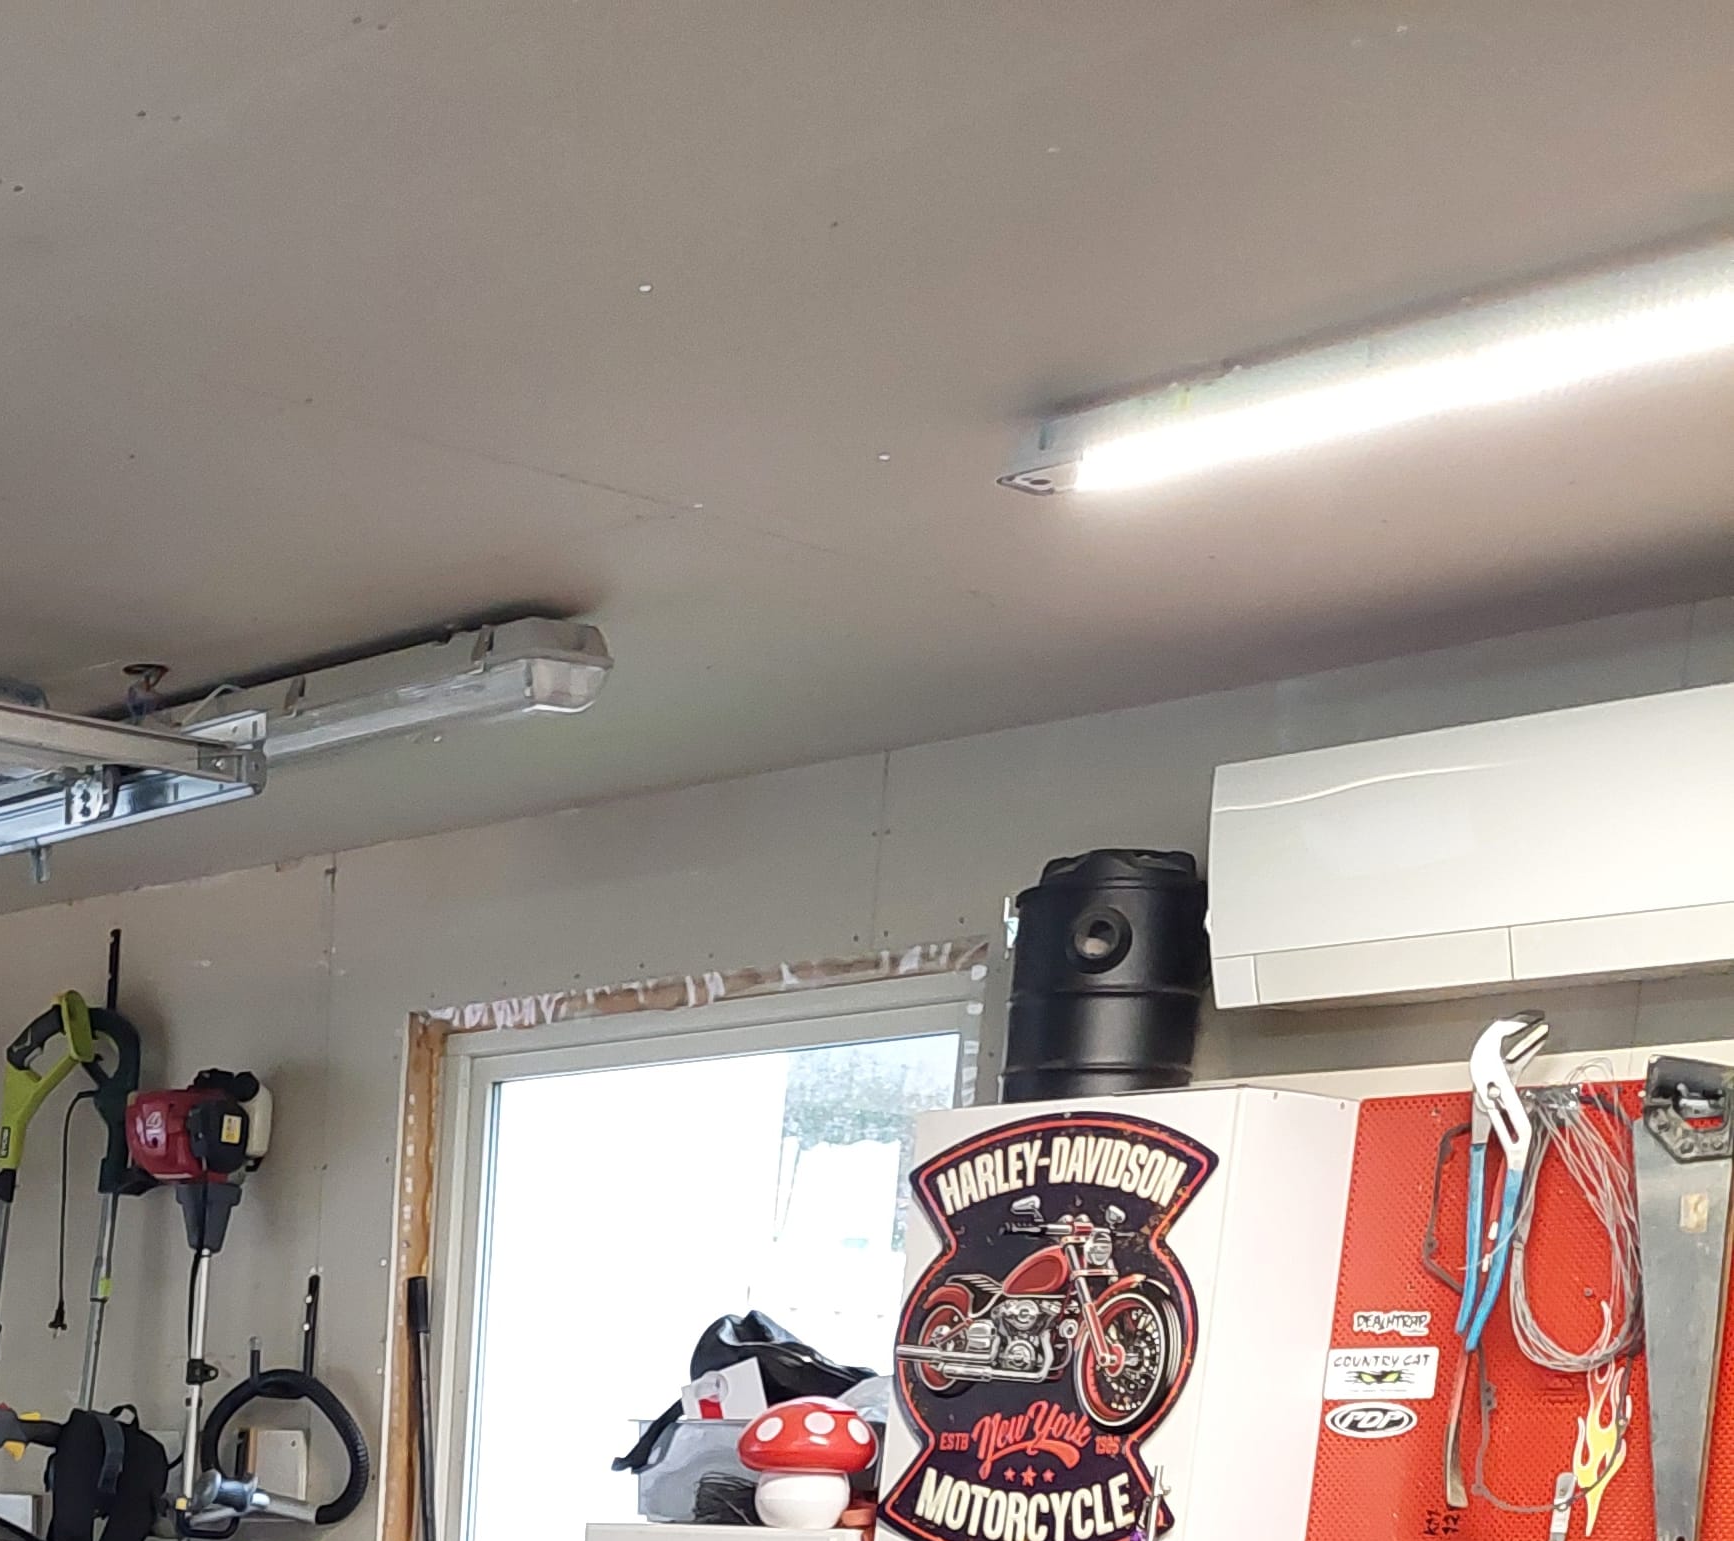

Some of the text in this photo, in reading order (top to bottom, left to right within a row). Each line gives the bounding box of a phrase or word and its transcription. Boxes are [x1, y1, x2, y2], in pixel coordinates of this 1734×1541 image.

[936, 1136, 1188, 1216] HARLEY-DAVIDSON
[1333, 1354, 1430, 1368] COUNTRY CAT
[971, 1400, 1092, 1466] New York
